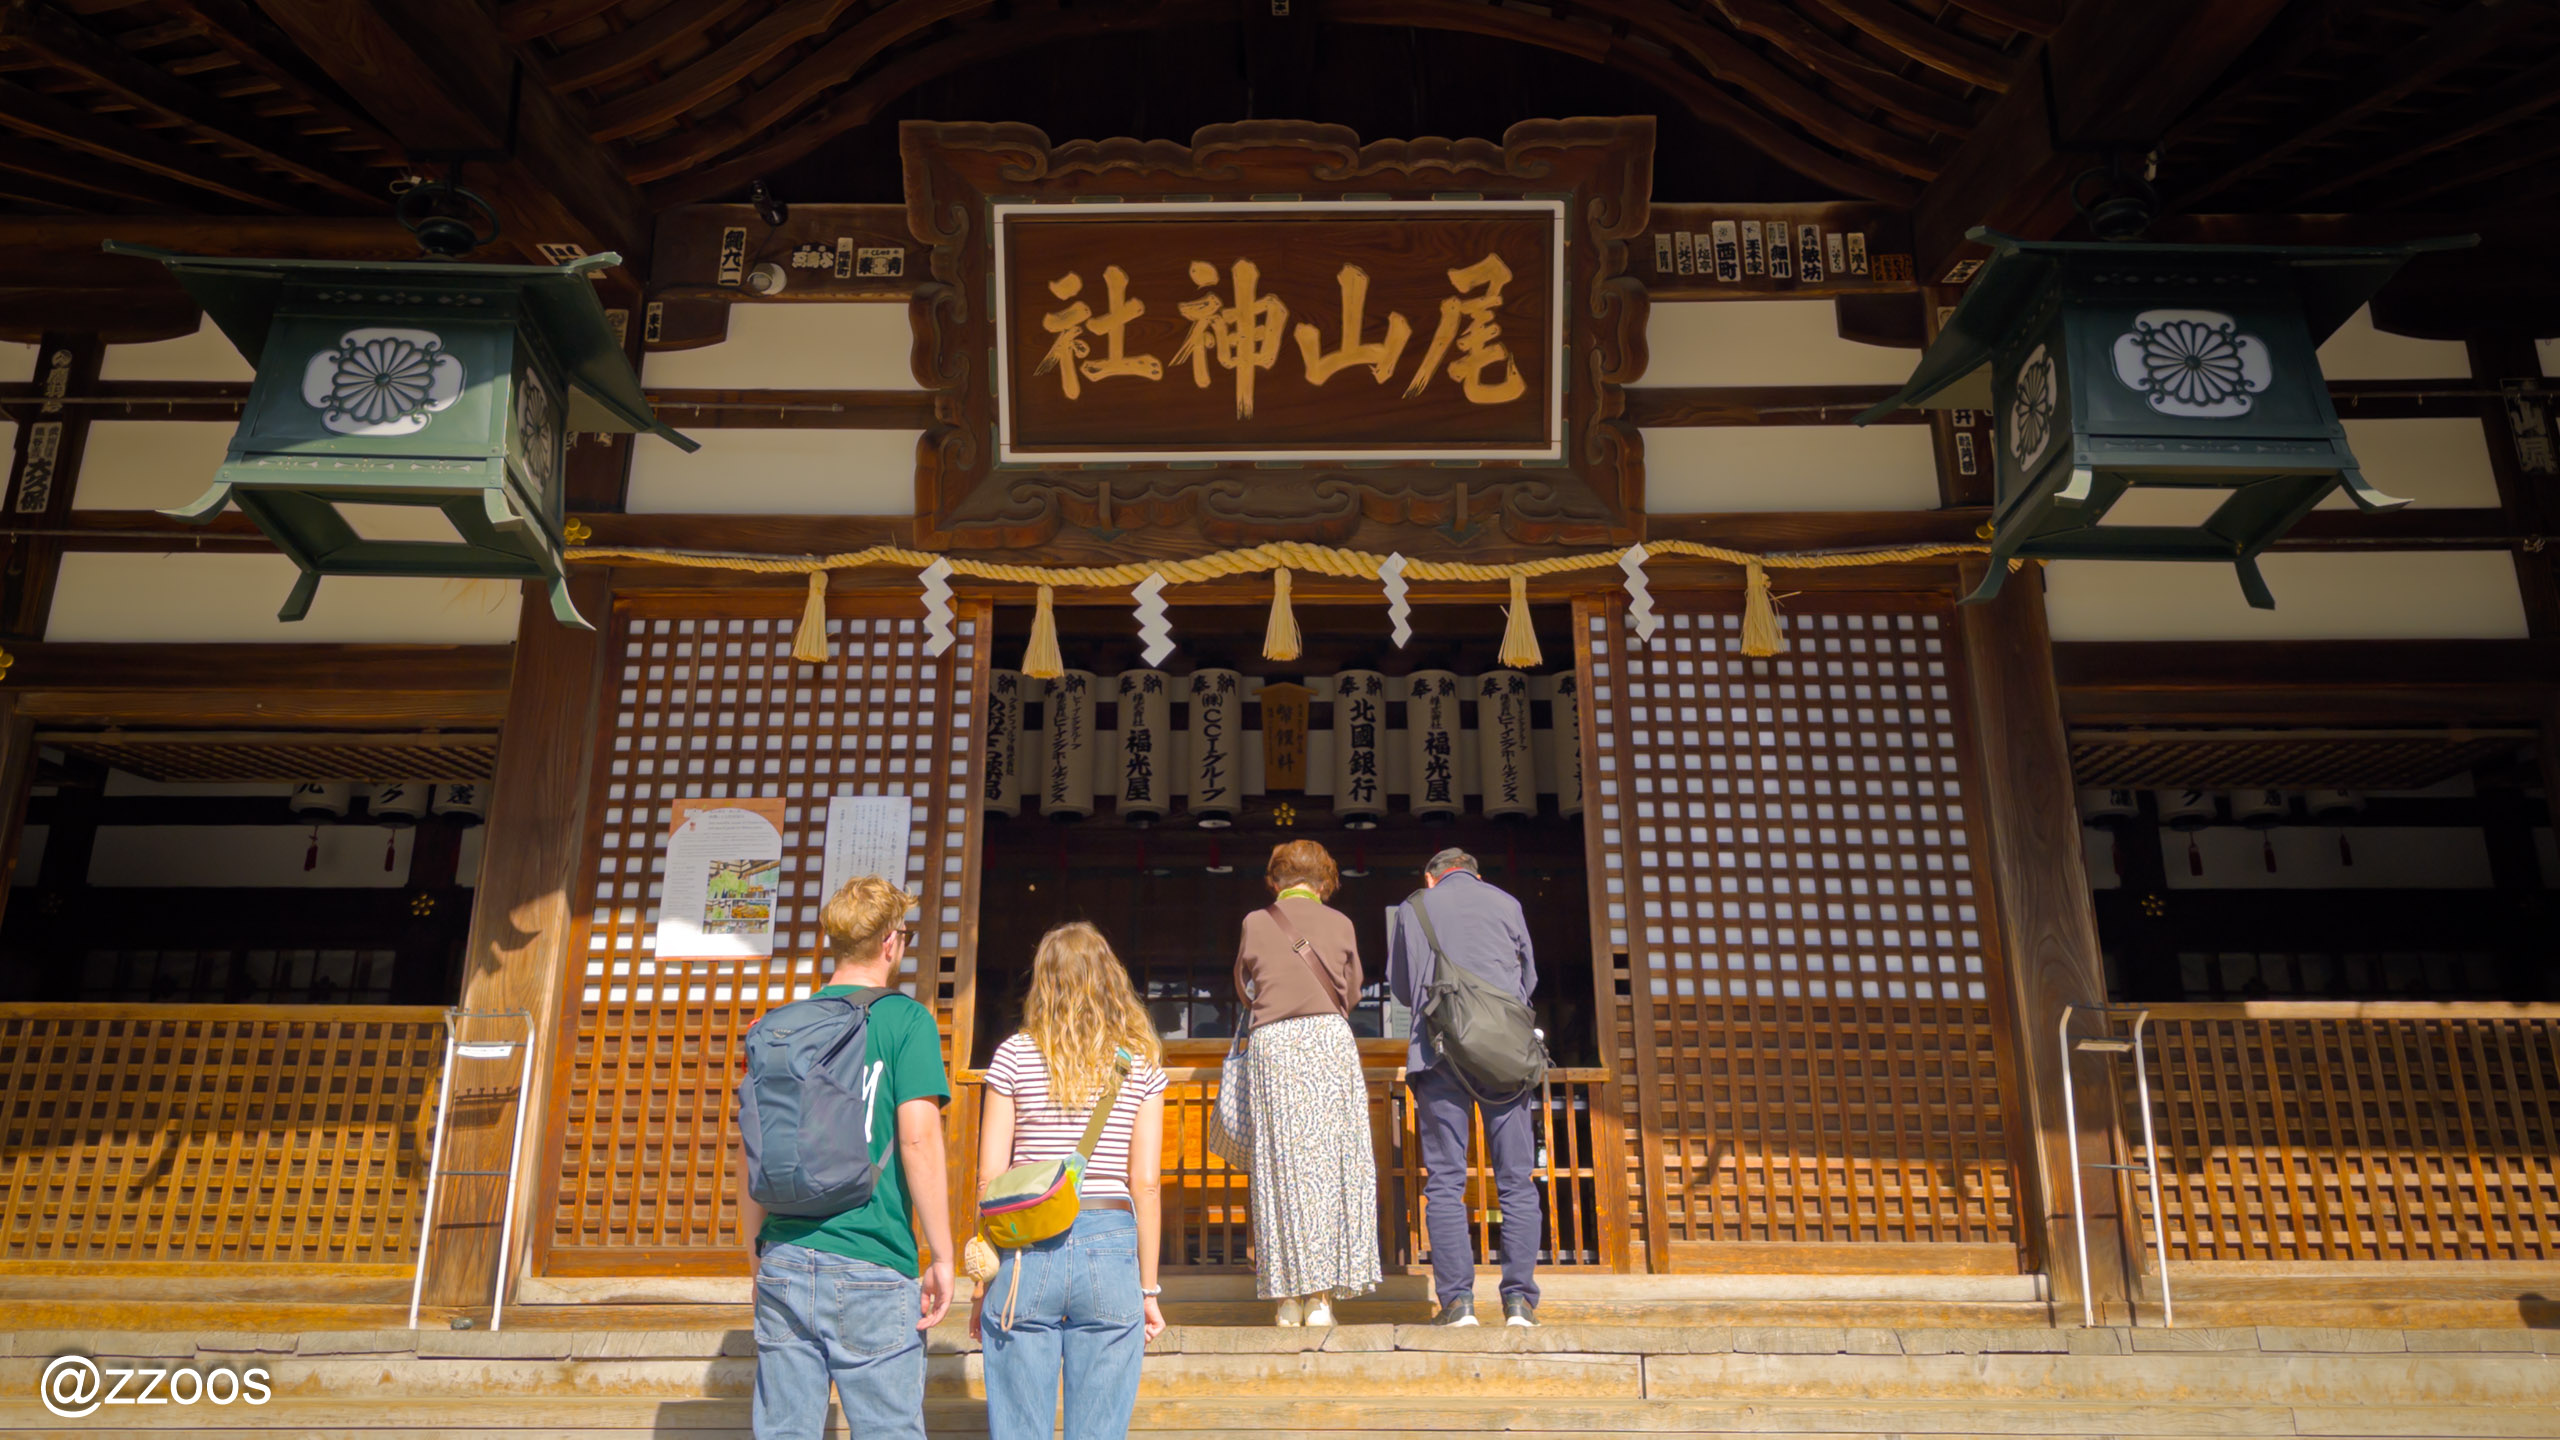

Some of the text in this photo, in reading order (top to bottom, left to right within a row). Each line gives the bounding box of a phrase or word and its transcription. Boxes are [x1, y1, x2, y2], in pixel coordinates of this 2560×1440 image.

[1032, 252, 1527, 420] 尾山神社
[1119, 673, 1163, 696] 奉納
[1191, 672, 1237, 697] 奉納
[1337, 675, 1384, 699] 奉納
[1410, 676, 1457, 700] 奉納
[1481, 675, 1527, 699] 奉納
[1348, 698, 1378, 803] 北國銀行
